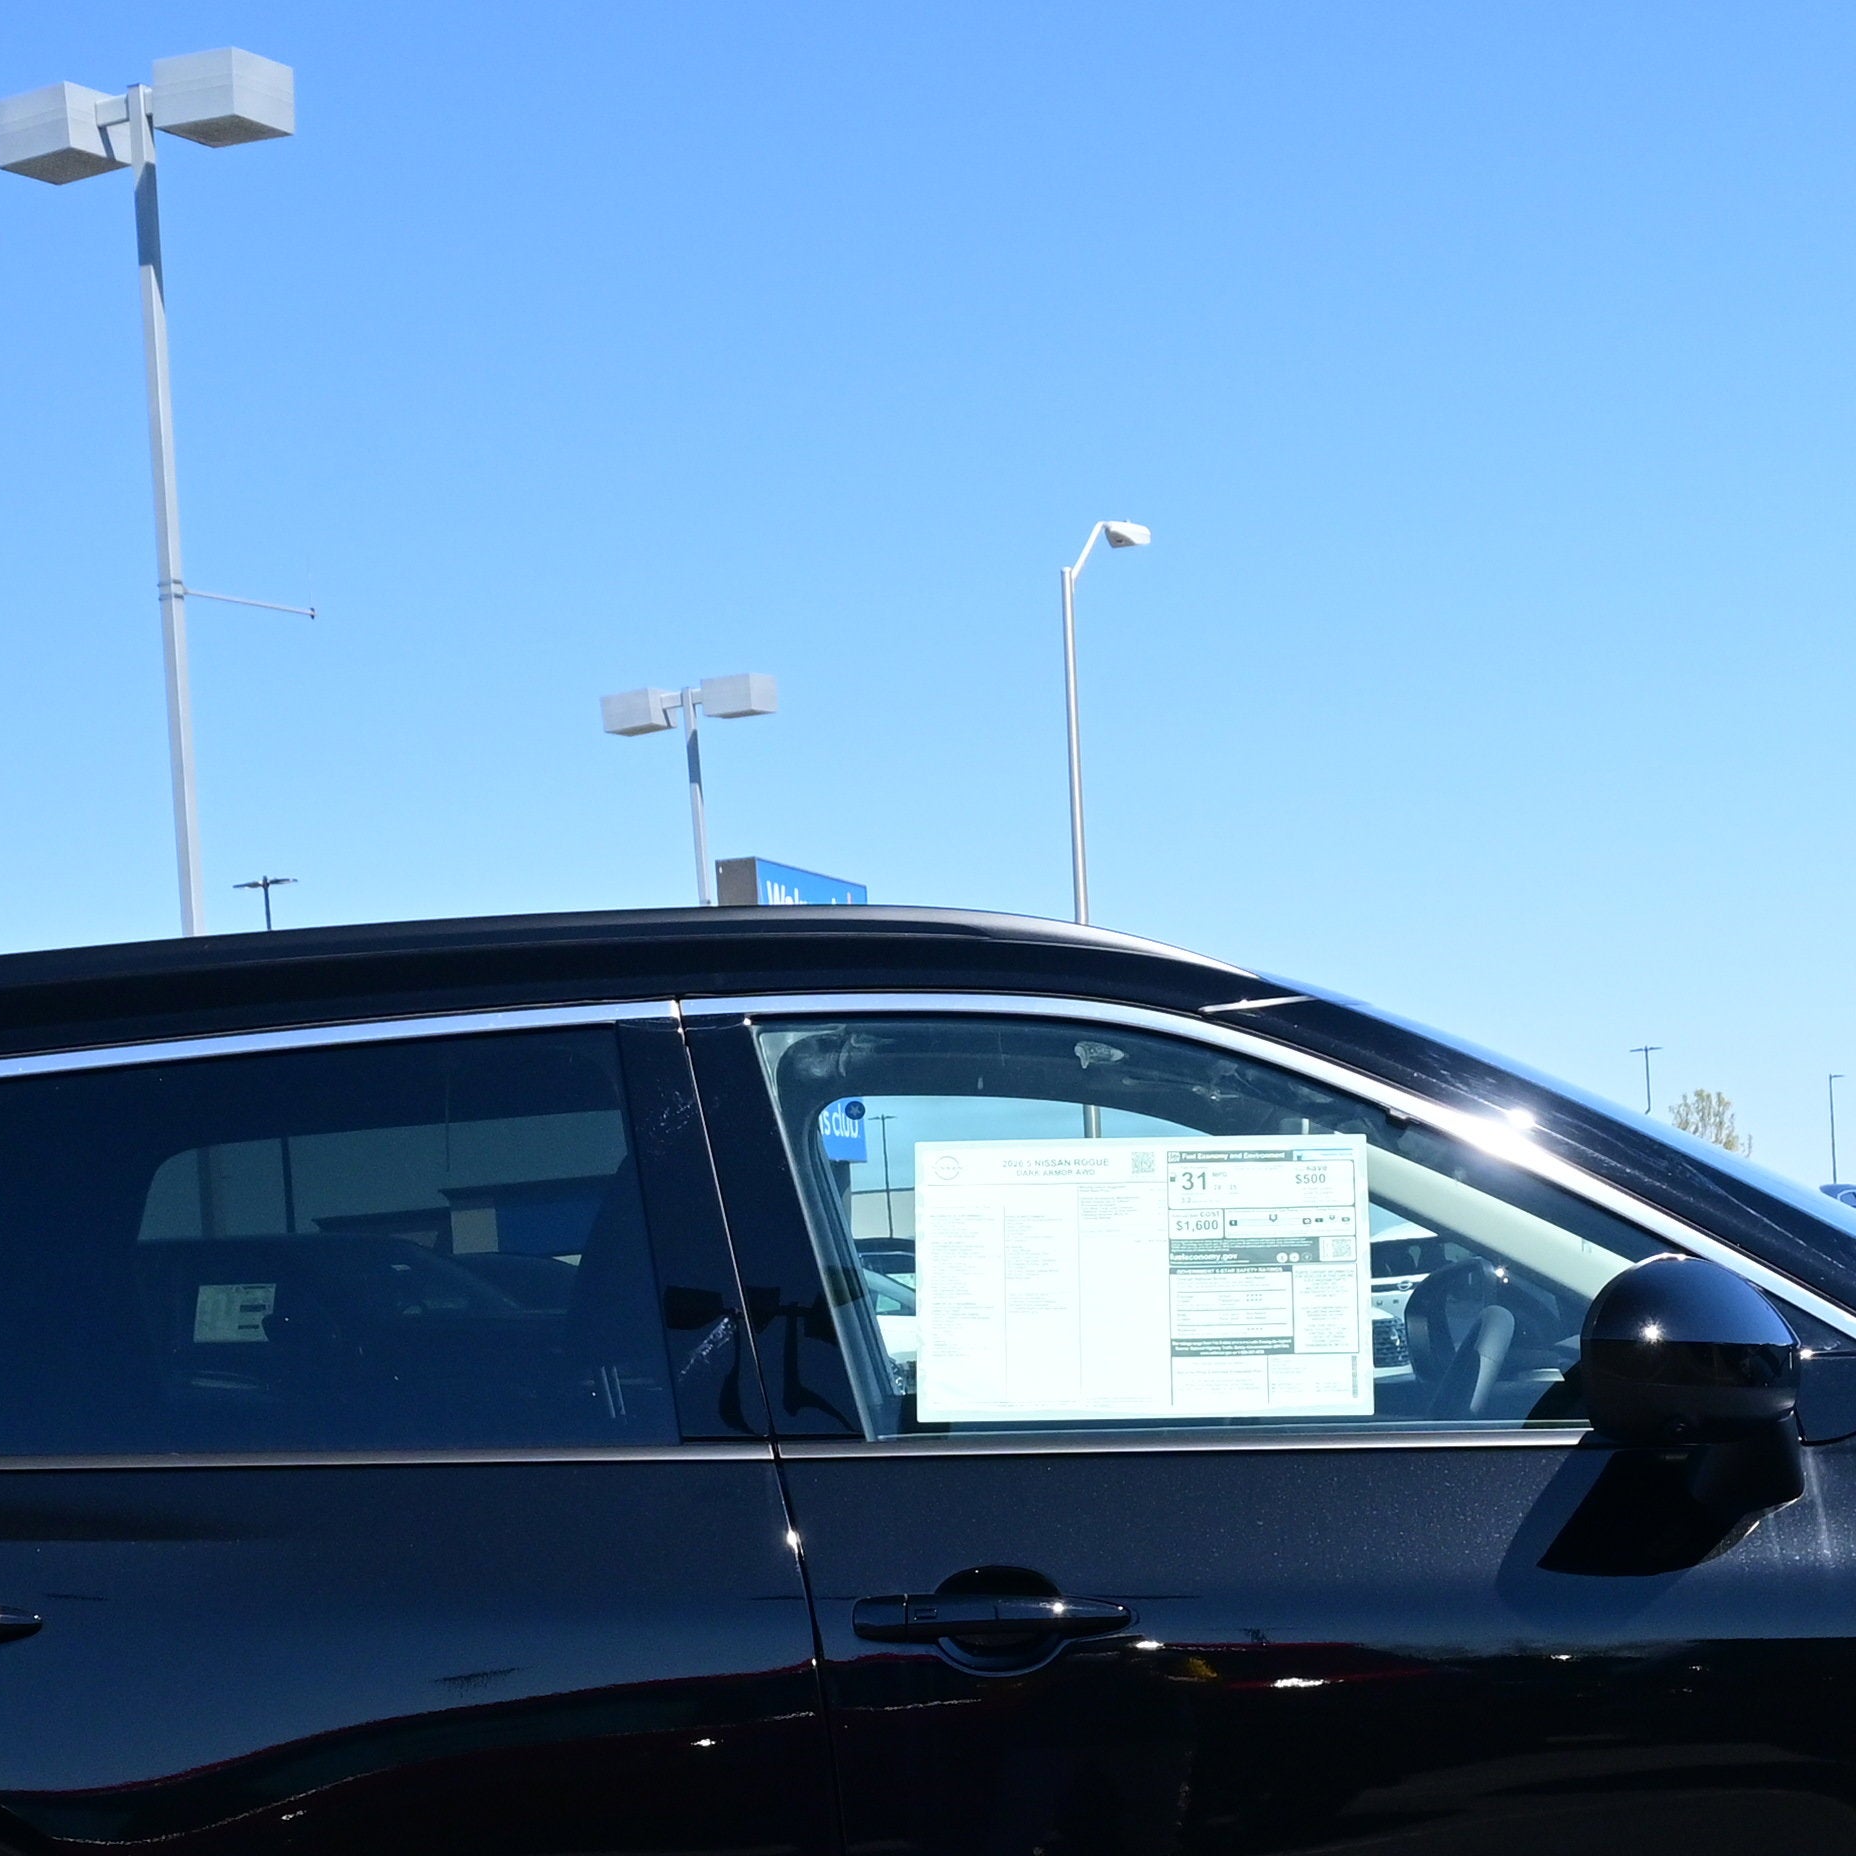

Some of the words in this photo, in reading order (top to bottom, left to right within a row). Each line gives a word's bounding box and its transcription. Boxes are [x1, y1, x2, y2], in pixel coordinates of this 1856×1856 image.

[1035, 1159, 1071, 1168] NISSAN
[1073, 1158, 1109, 1167] ROGUE
[1181, 1171, 1206, 1191] 31
[1295, 1173, 1326, 1185] $500
[1176, 1219, 1219, 1232] $1,600
